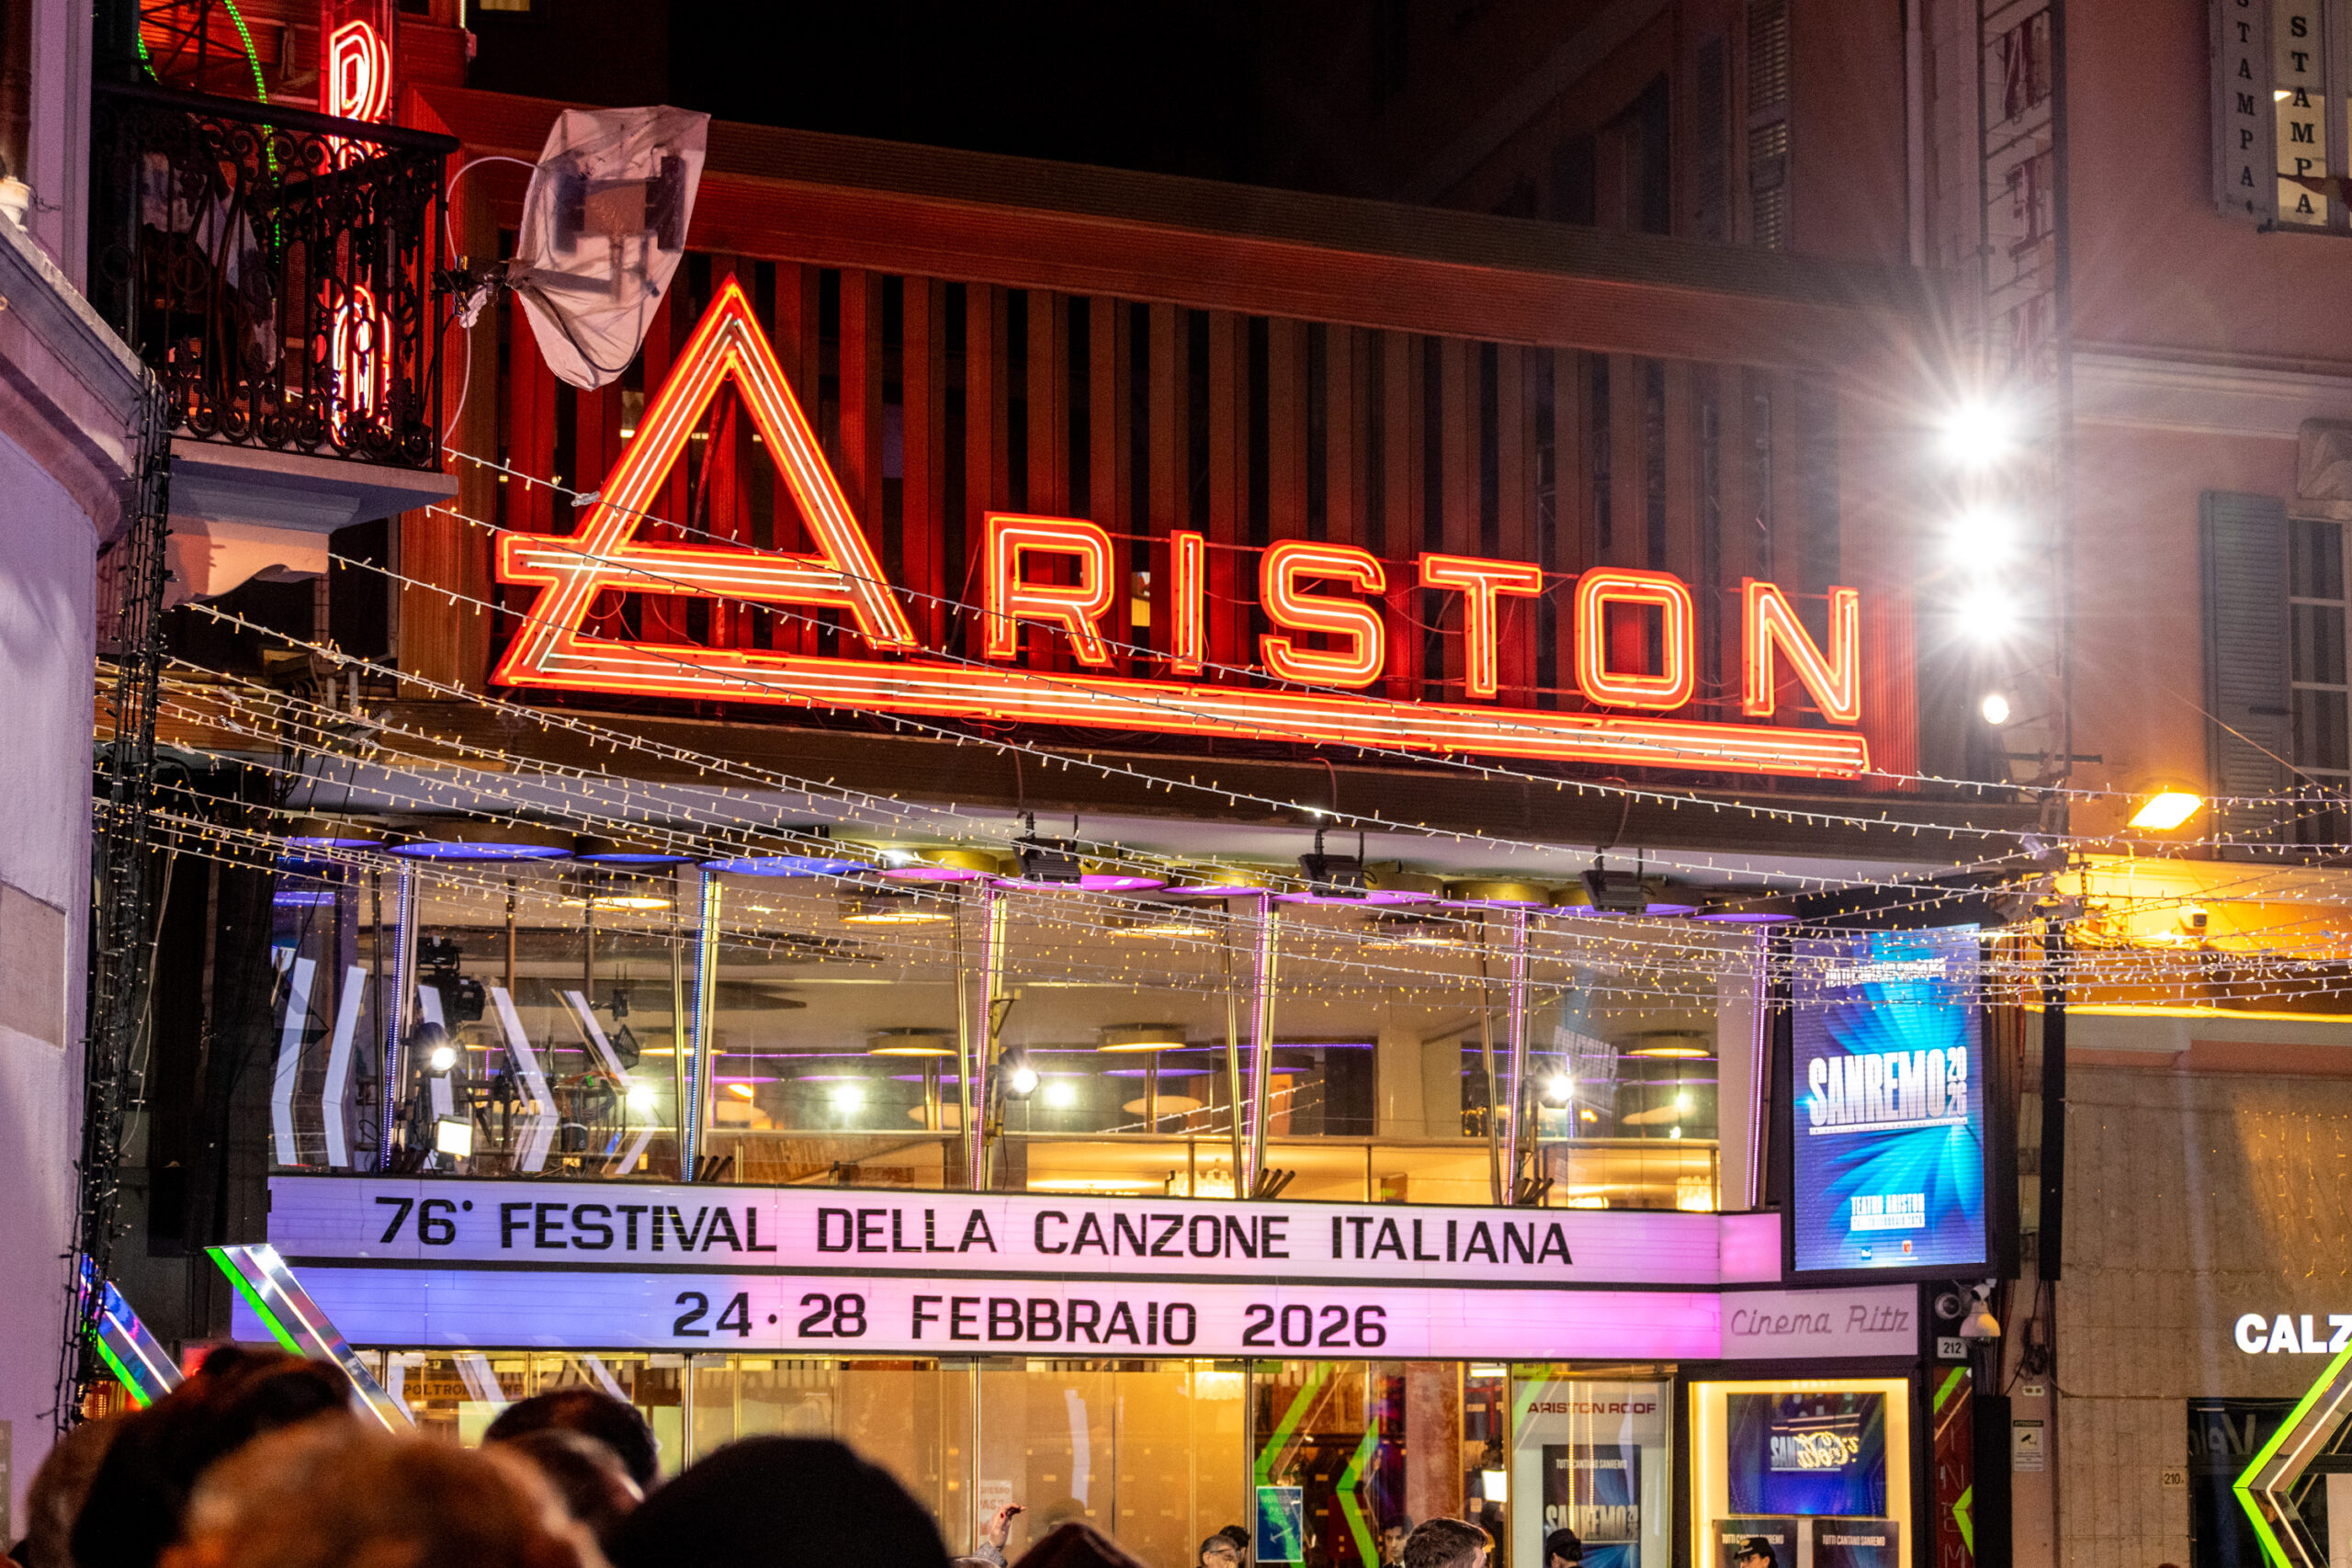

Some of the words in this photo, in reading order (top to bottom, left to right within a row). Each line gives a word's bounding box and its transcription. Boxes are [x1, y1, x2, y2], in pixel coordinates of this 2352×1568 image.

[2290, 16, 2315, 214] STAMPA
[489, 274, 1865, 730] ARISTON
[1808, 1049, 1946, 1126] SANREMO
[500, 1201, 777, 1253] FESTIVAL
[818, 1208, 997, 1253] DELLA
[1035, 1211, 1290, 1258] CANZONE
[1332, 1216, 1573, 1265] ITALIANA
[912, 1295, 1196, 1346] FEBBRAIO
[1243, 1304, 1385, 1347] 2026
[1731, 1308, 1832, 1336] Cinema
[1846, 1304, 1909, 1333] Ritz
[1943, 1342, 1962, 1355] 212
[1527, 1402, 1605, 1415] ARISTON
[1609, 1403, 1657, 1415] ROOF
